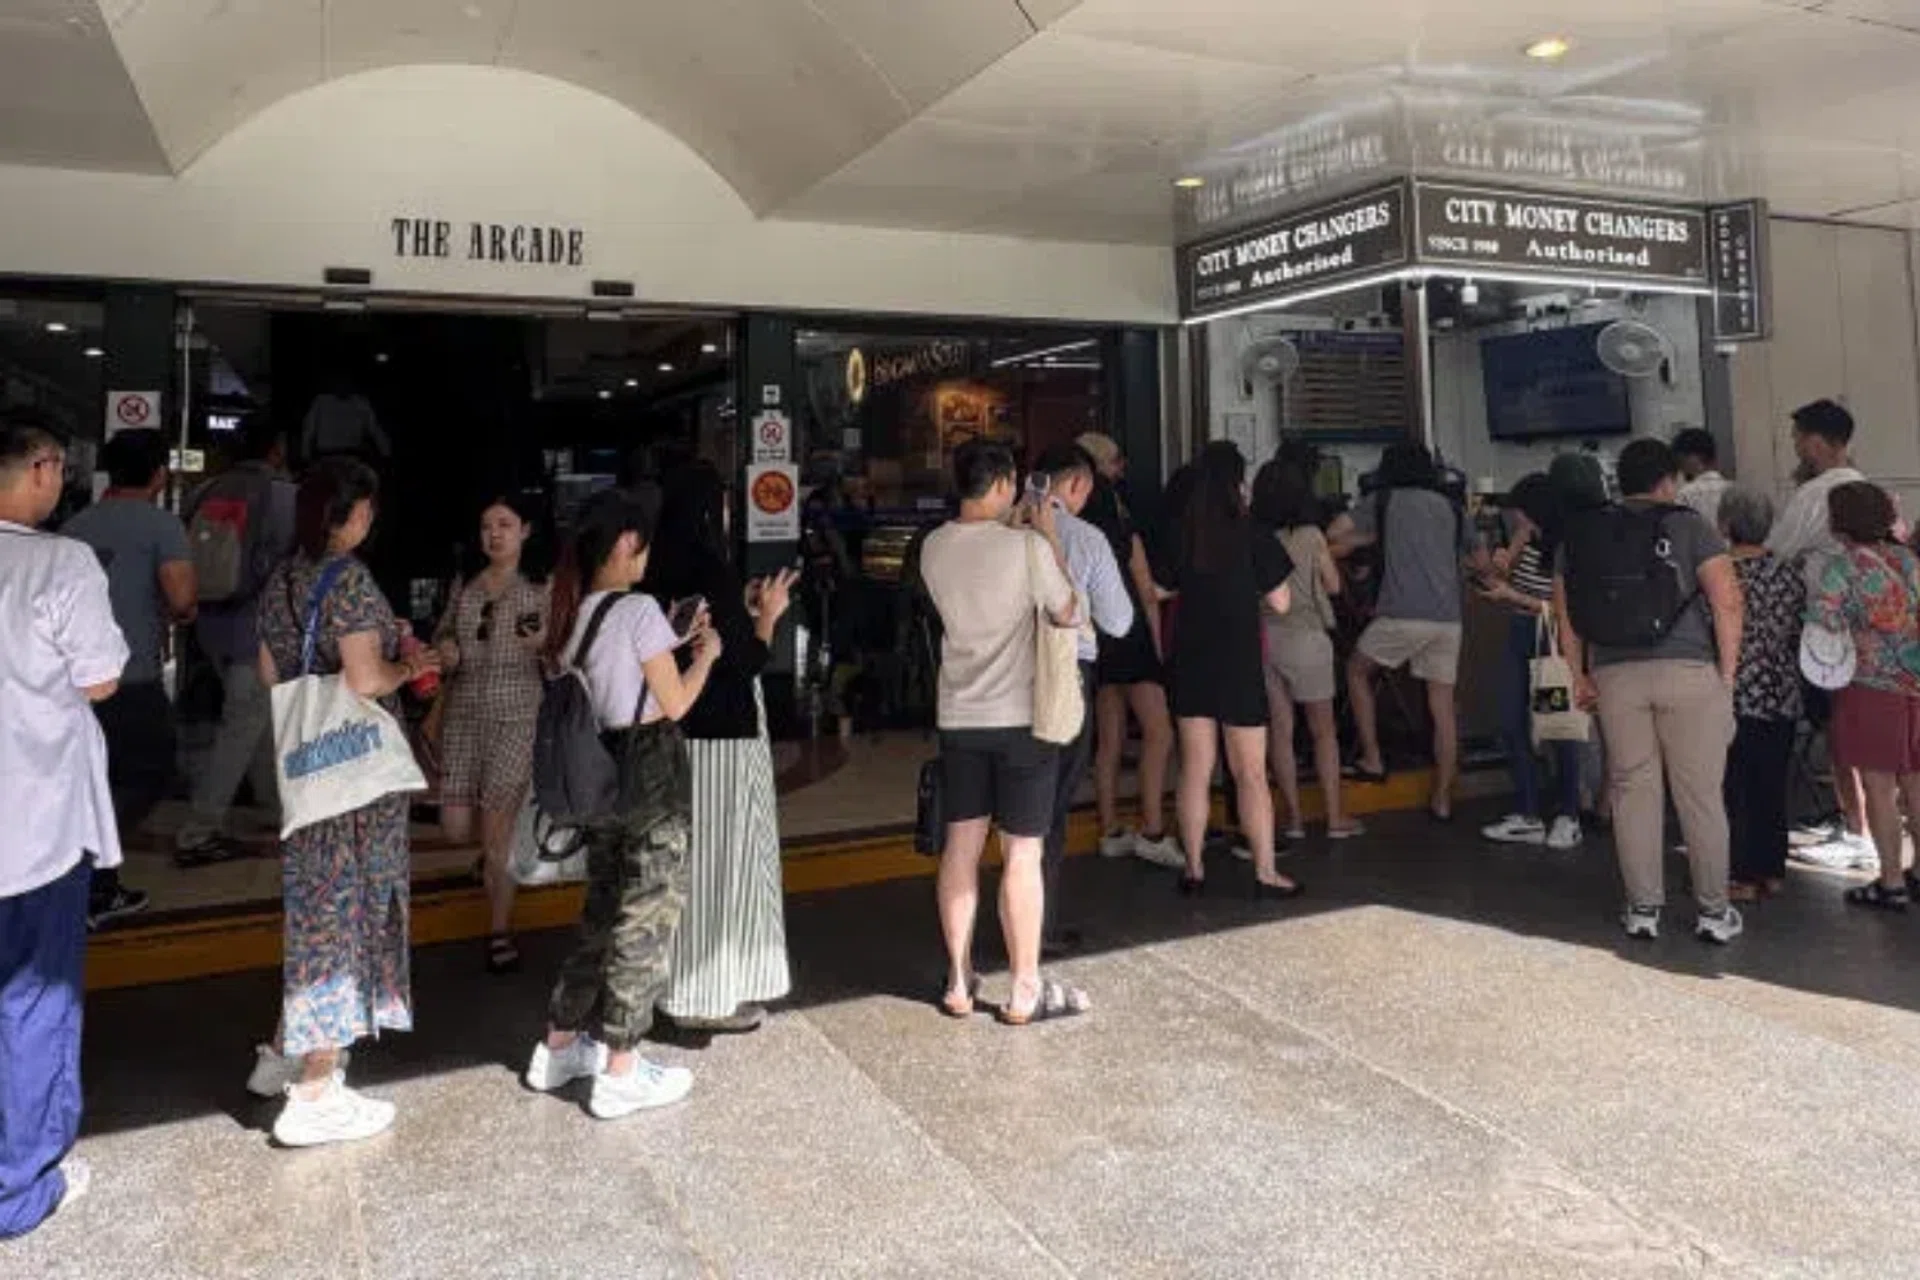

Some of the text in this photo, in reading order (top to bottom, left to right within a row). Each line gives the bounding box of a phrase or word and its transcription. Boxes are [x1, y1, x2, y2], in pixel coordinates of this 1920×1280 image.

[392, 218, 584, 266] THE ARCADE
[1197, 202, 1390, 276] CITY MONEY CHANGERS
[1445, 197, 1690, 242] CITY MONEY CHANGERS
[1251, 245, 1353, 288] Authorised
[1526, 238, 1651, 267] Authorised
